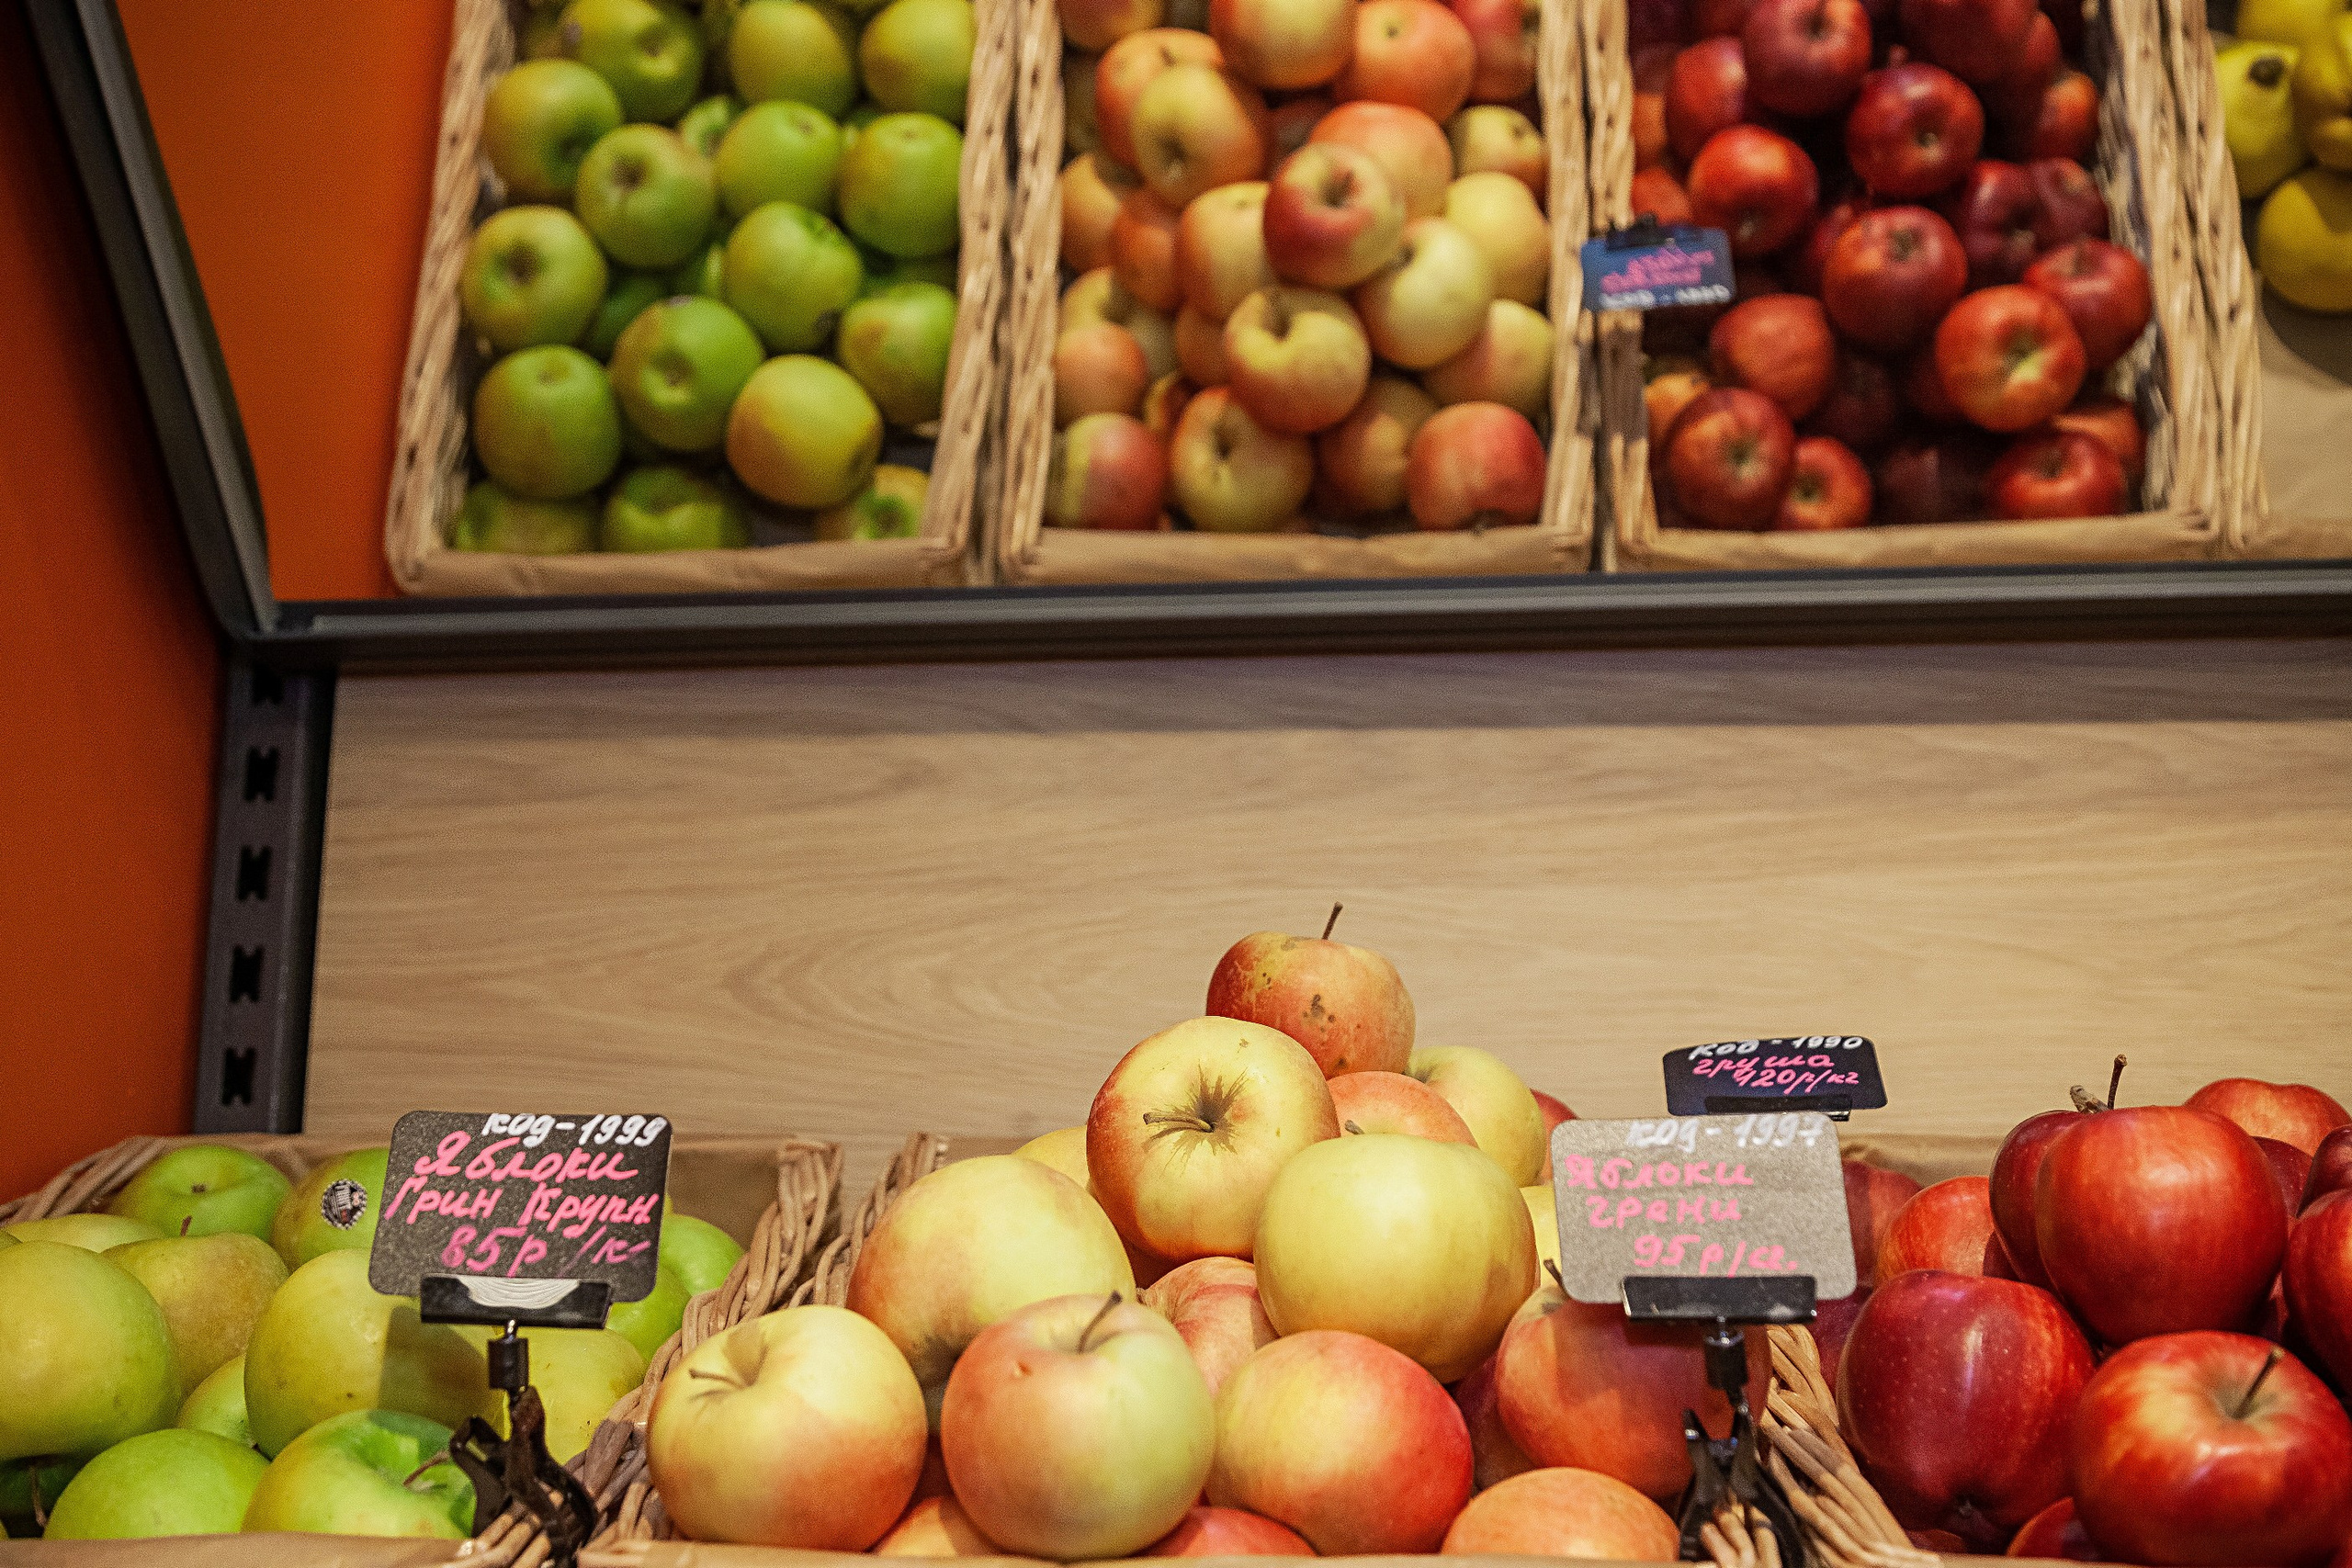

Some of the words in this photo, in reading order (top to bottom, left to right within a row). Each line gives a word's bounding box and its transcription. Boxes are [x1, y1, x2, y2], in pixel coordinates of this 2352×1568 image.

[1692, 1055, 1836, 1078] груша
[414, 1131, 639, 1183] Яблоки
[1565, 1154, 1754, 1190] Яблоки
[384, 1177, 503, 1225] Грин
